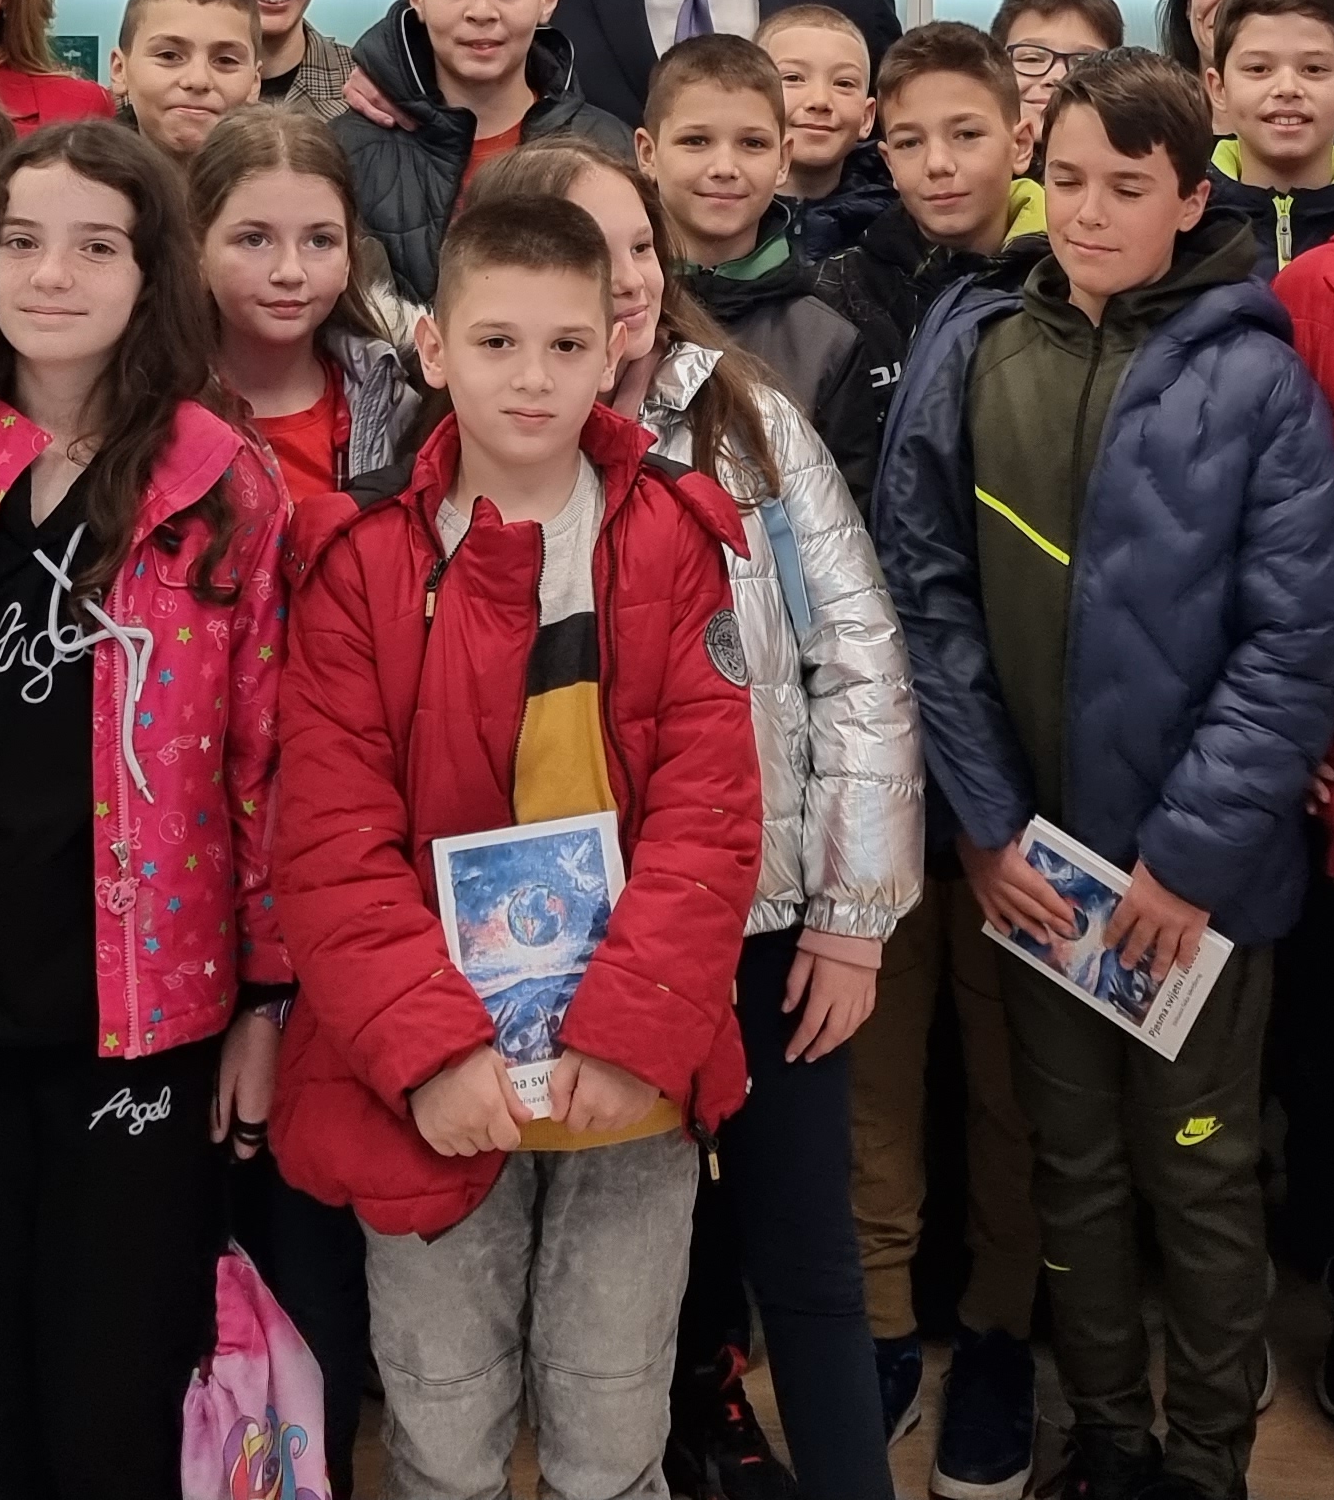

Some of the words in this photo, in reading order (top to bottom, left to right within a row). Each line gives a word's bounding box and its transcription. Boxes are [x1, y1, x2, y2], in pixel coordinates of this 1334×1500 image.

[1148, 1008, 1169, 1038] Pjesma
[1166, 979, 1184, 1008] svijetu
[1184, 1117, 1217, 1135] NIKE
